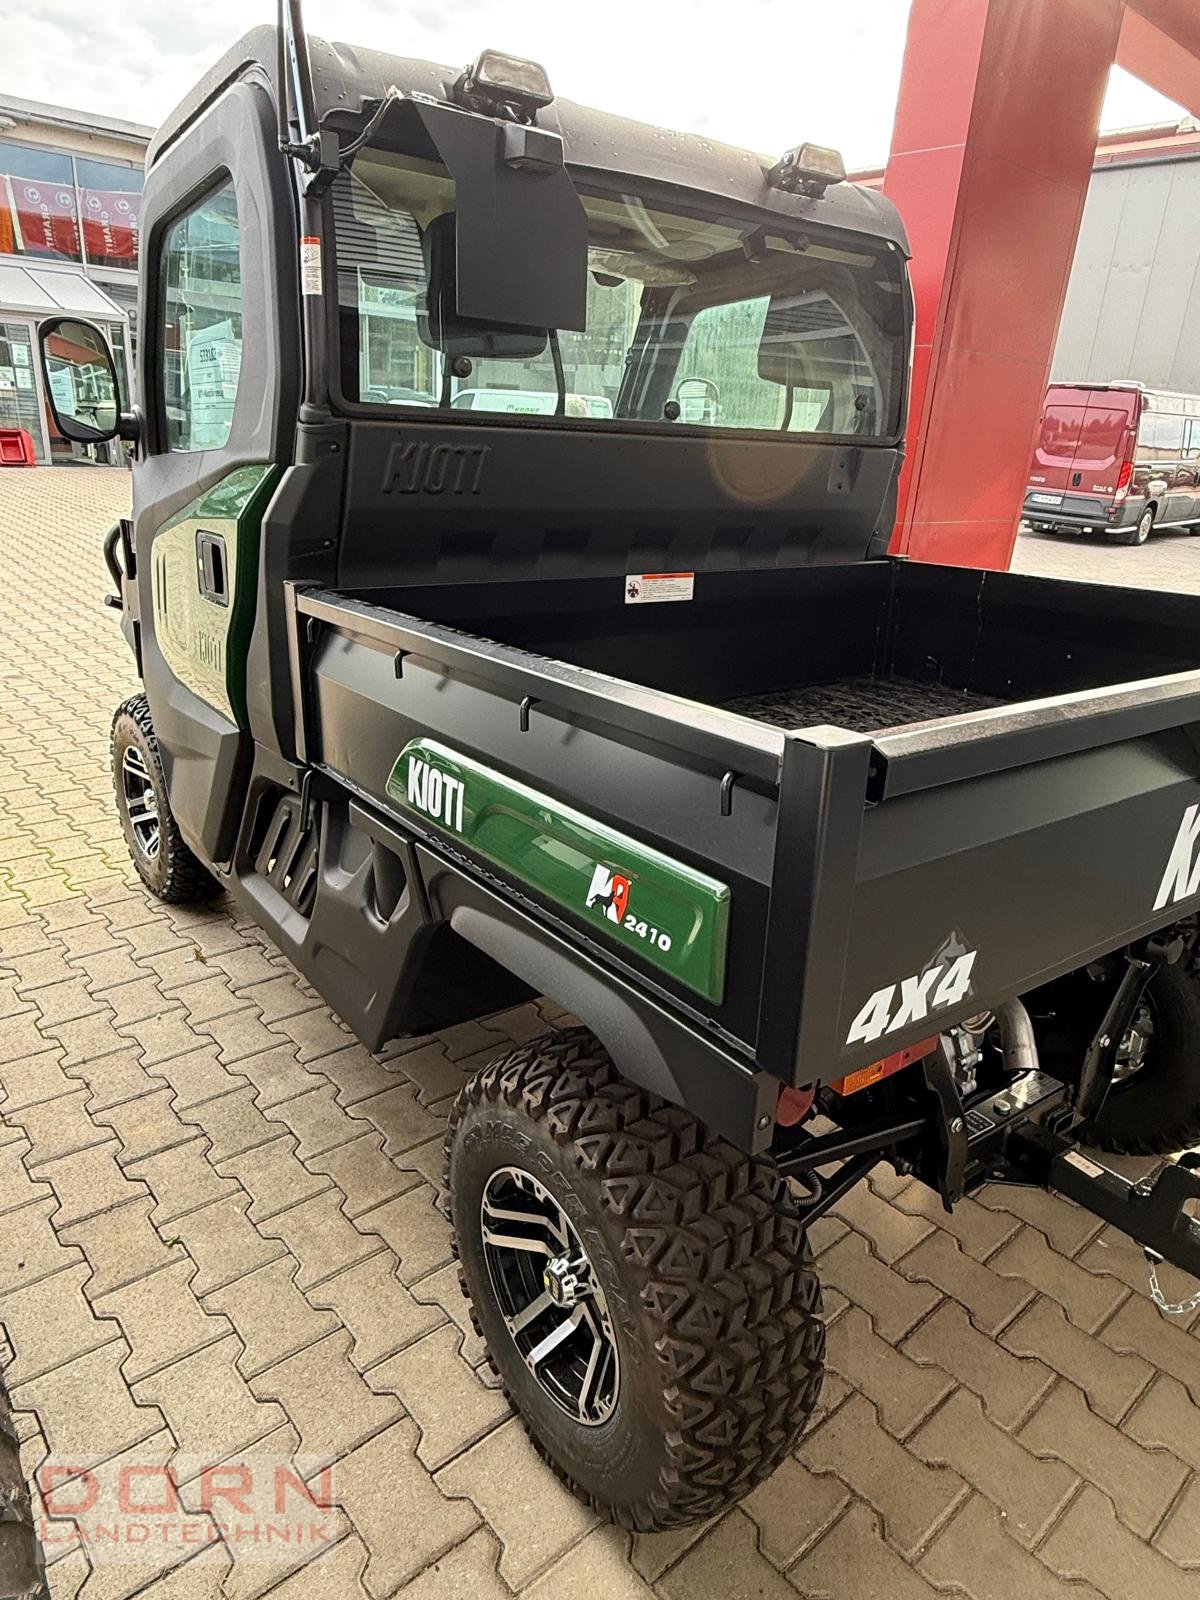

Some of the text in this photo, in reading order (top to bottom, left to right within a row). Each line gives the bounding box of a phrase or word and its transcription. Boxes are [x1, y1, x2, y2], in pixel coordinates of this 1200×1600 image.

[382, 442, 492, 494] KIOTI
[407, 755, 465, 833] KIOTI
[623, 914, 672, 952] 2410
[846, 950, 977, 1045] 4X4
